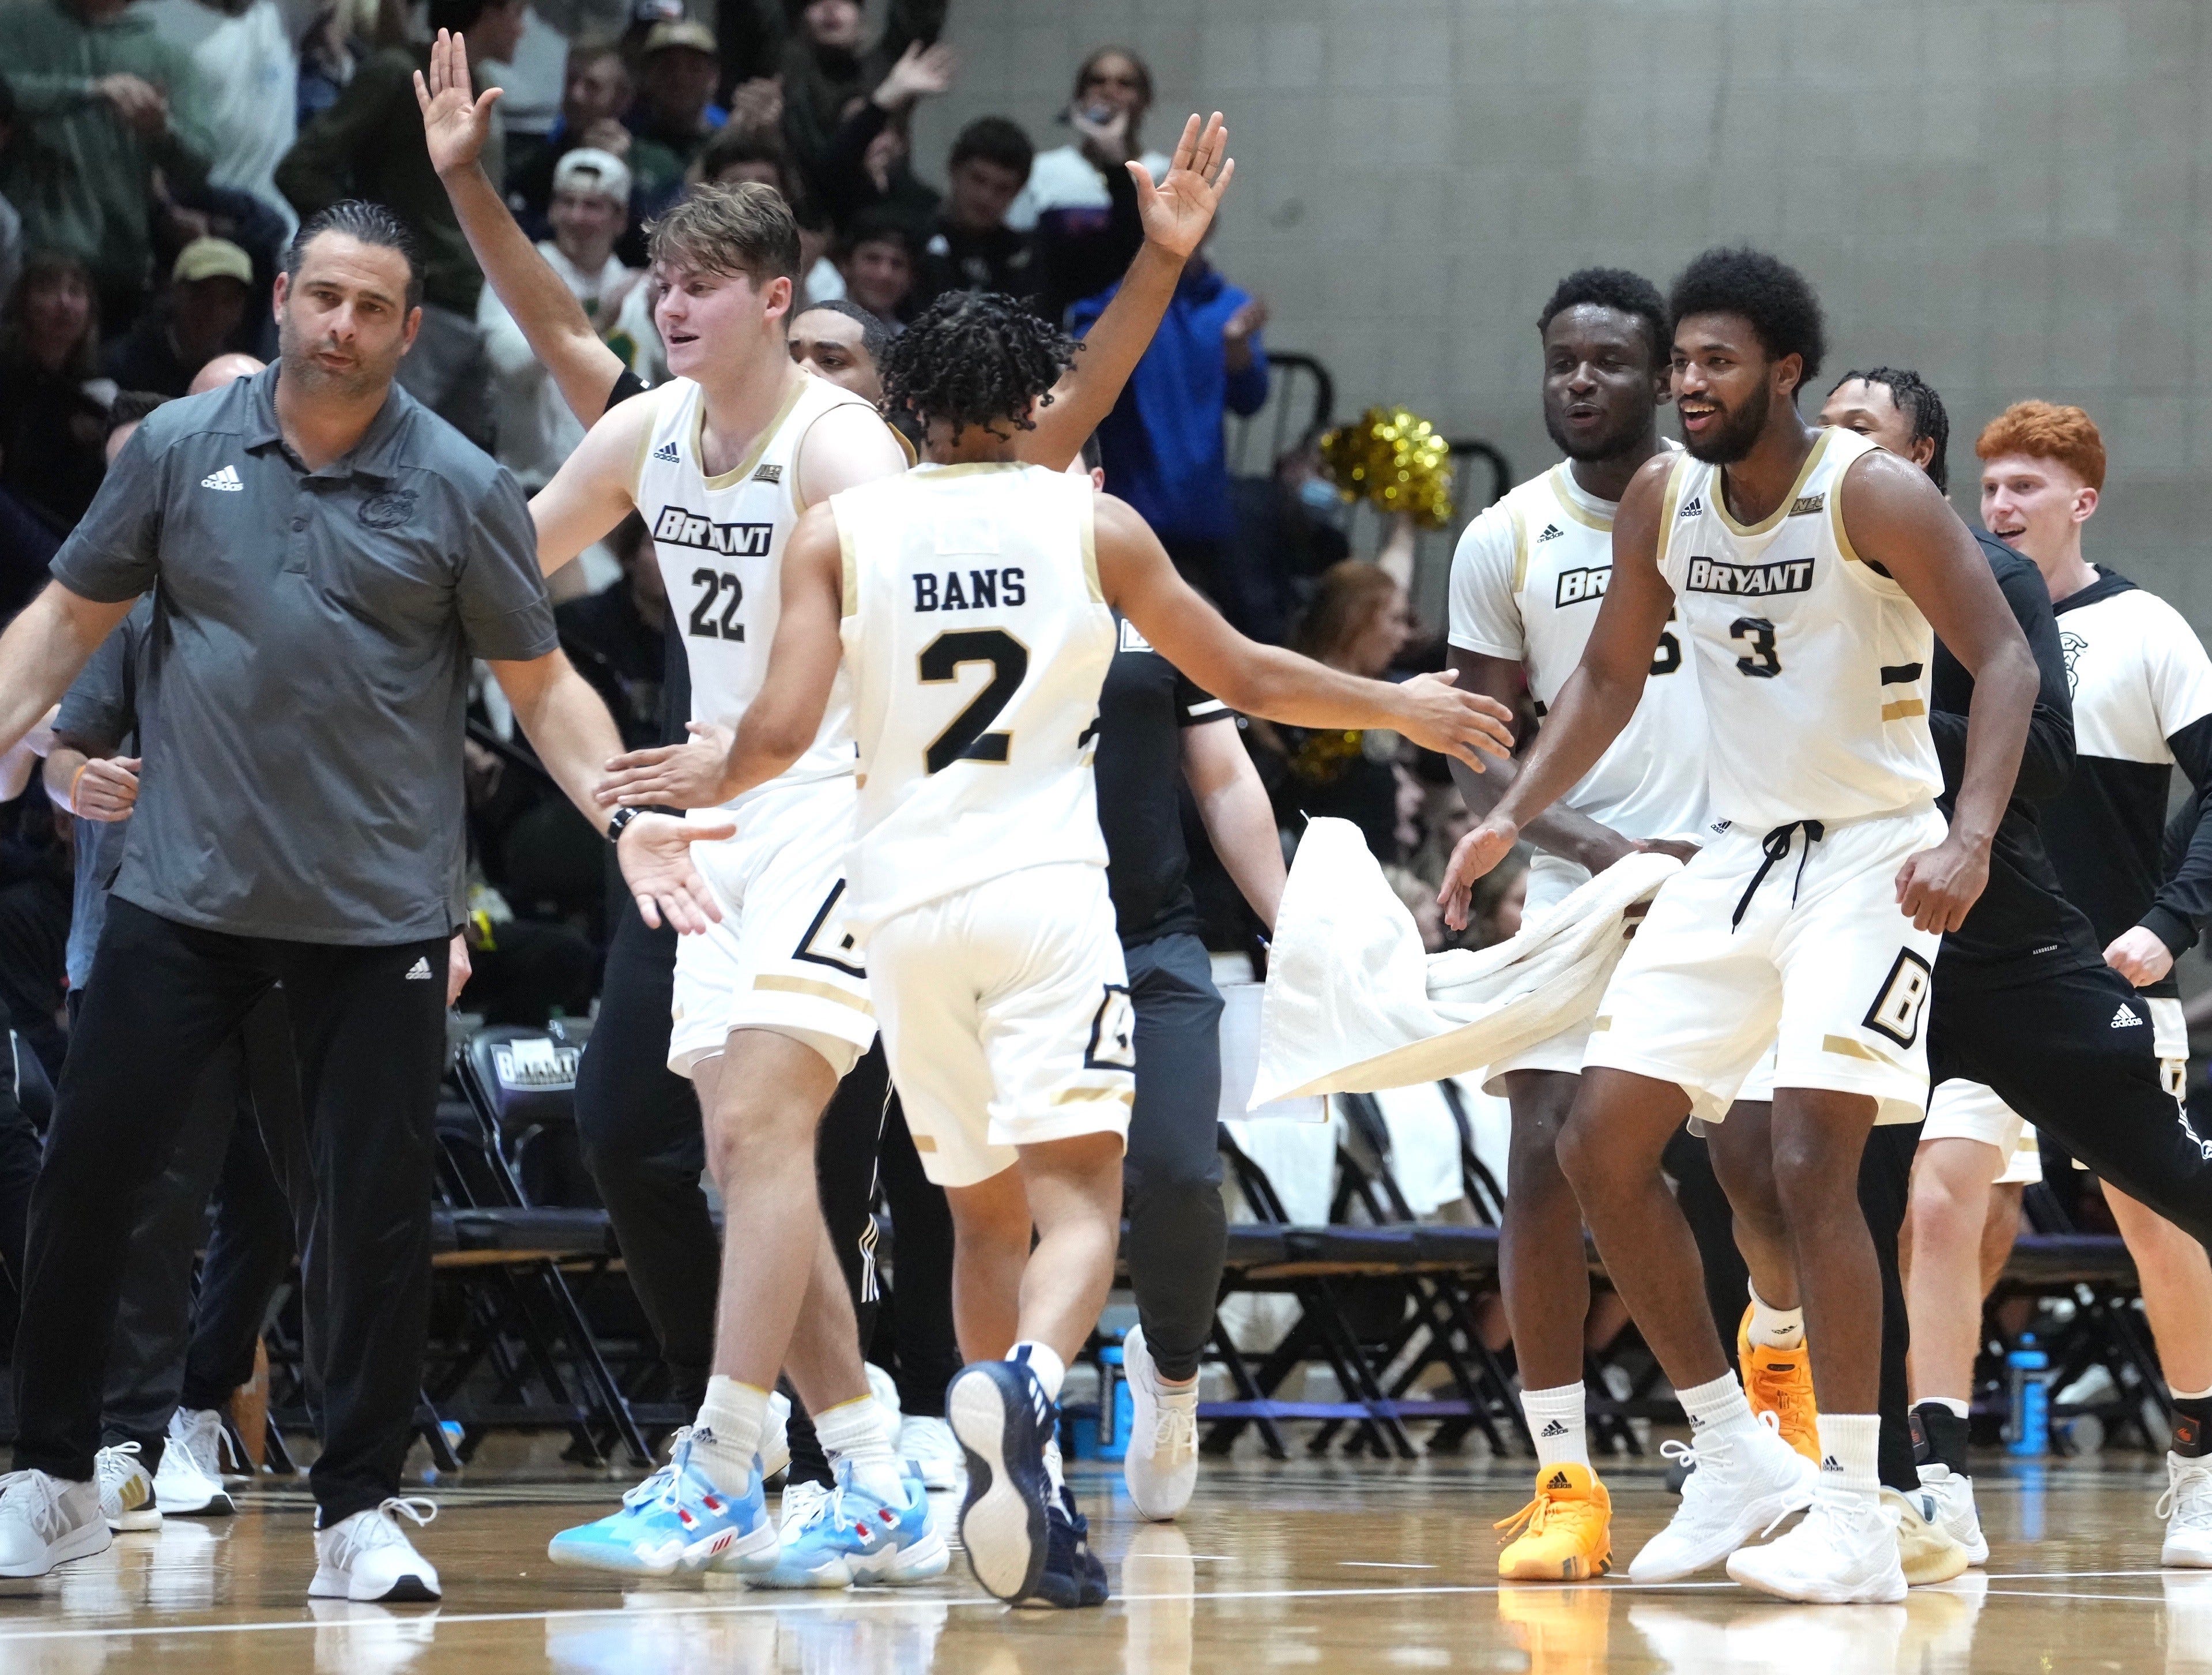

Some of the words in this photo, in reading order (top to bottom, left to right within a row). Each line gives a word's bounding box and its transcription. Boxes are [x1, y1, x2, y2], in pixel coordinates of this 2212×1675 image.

[653, 453, 680, 463] adidas
[201, 479, 244, 491] adidas
[1537, 531, 1564, 543] adidas
[913, 567, 1026, 612] BANS
[1687, 558, 1813, 595] BRYANT
[688, 567, 745, 643] 22
[1729, 616, 1783, 679] 3
[915, 626, 1031, 778] 2
[1867, 951, 1931, 1045] B
[2111, 1017, 2143, 1029] adidas
[1541, 1428, 1569, 1437] adidas
